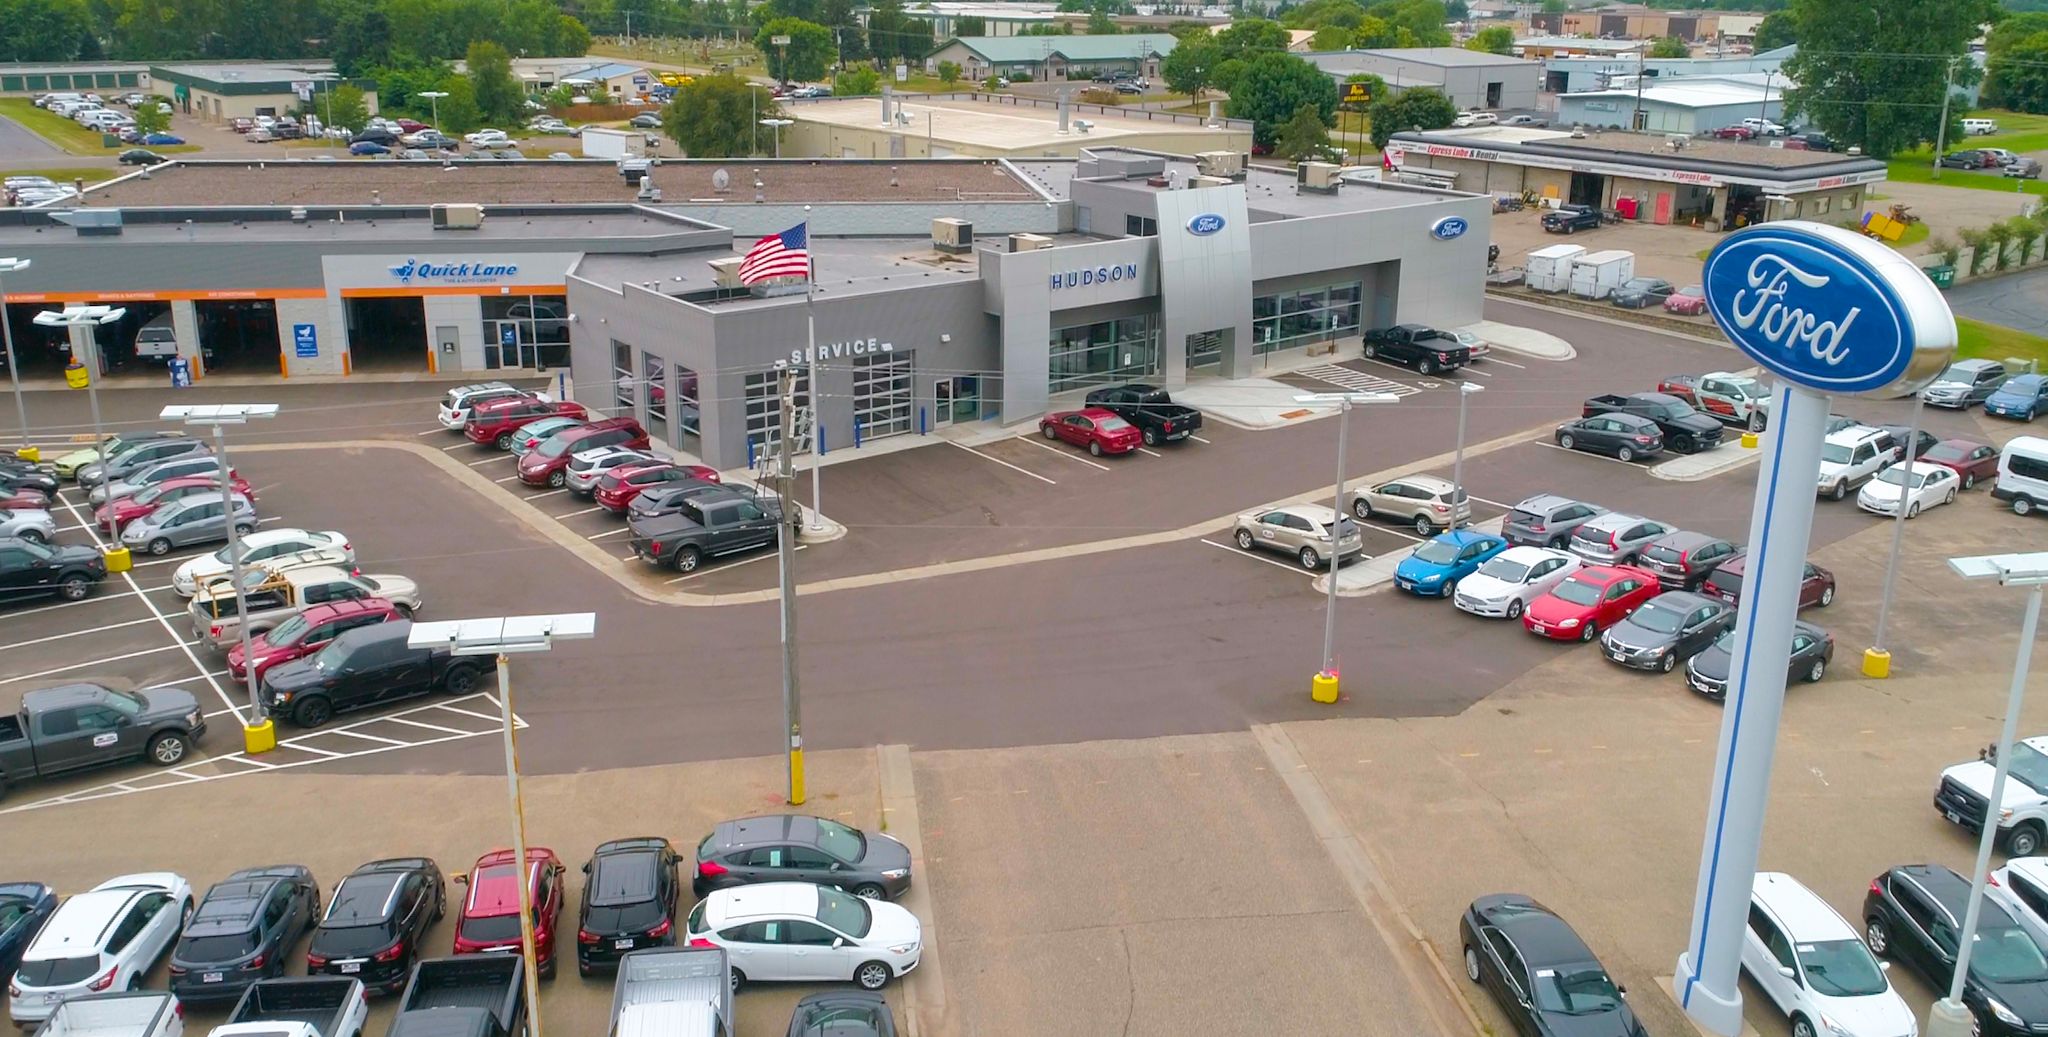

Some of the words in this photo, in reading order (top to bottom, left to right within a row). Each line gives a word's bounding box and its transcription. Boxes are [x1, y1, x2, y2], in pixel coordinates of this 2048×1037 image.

[1427, 145, 1452, 156] Express
[1452, 148, 1469, 157] Lube
[1469, 150, 1474, 158] &
[1475, 150, 1499, 160] Rental
[1672, 170, 1696, 180] Express
[1198, 217, 1218, 231] Ford
[1441, 222, 1462, 236] Ford
[417, 263, 469, 278] Quick
[472, 263, 517, 276] Lane
[1051, 263, 1137, 290] HUDSON
[1733, 254, 1861, 366] Ford
